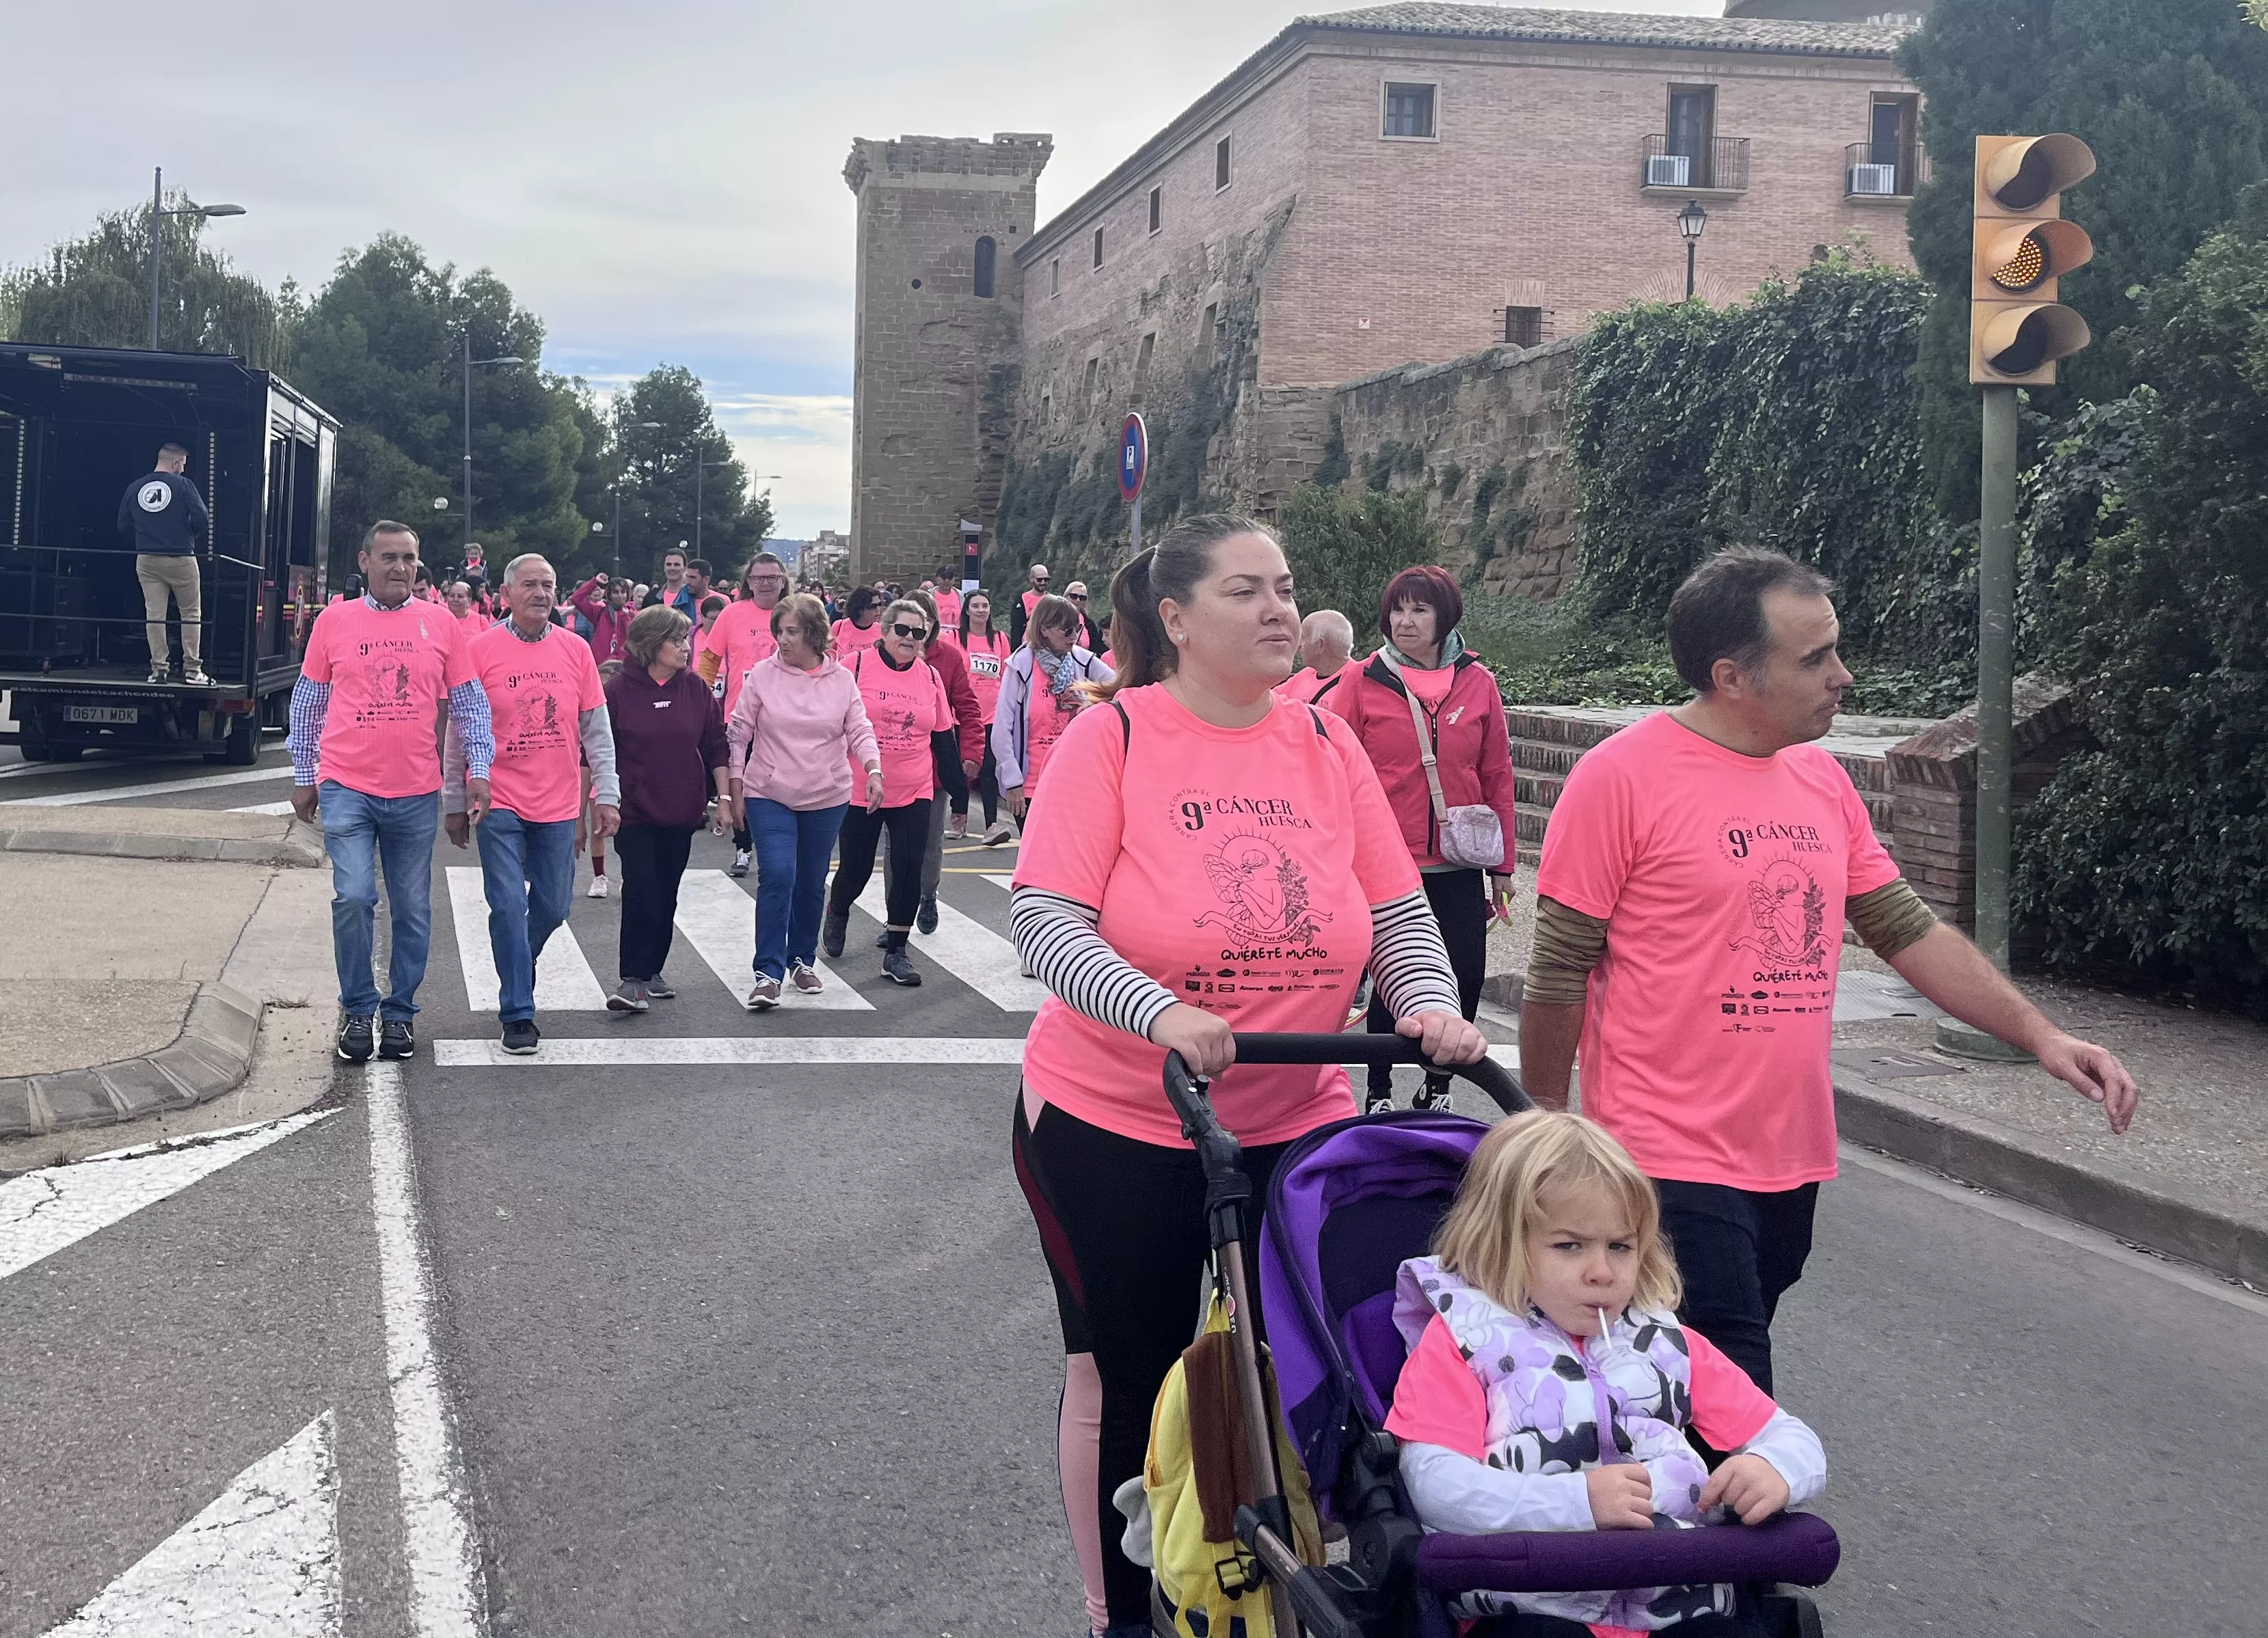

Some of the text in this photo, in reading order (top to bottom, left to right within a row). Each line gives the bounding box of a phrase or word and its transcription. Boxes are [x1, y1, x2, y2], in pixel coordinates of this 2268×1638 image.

[1128, 447, 1133, 461] P
[375, 639, 413, 649] CÁNCER
[973, 660, 998, 673] 1170
[523, 671, 556, 681] CÁNCER
[72, 707, 134, 722] 0671 MDK
[1169, 788, 1210, 841] CARRERA CONTRA EL
[1181, 795, 1293, 831] 9ª CÁNCER
[1258, 816, 1312, 829] HUESCA
[1718, 816, 1741, 836] CONTRA
[1728, 821, 1820, 858] 9ª CÁNCER
[1717, 838, 1744, 869] CARRERA
[1792, 841, 1833, 854] HUESCA
[1221, 945, 1327, 962] QUIÉRETE MUCHO
